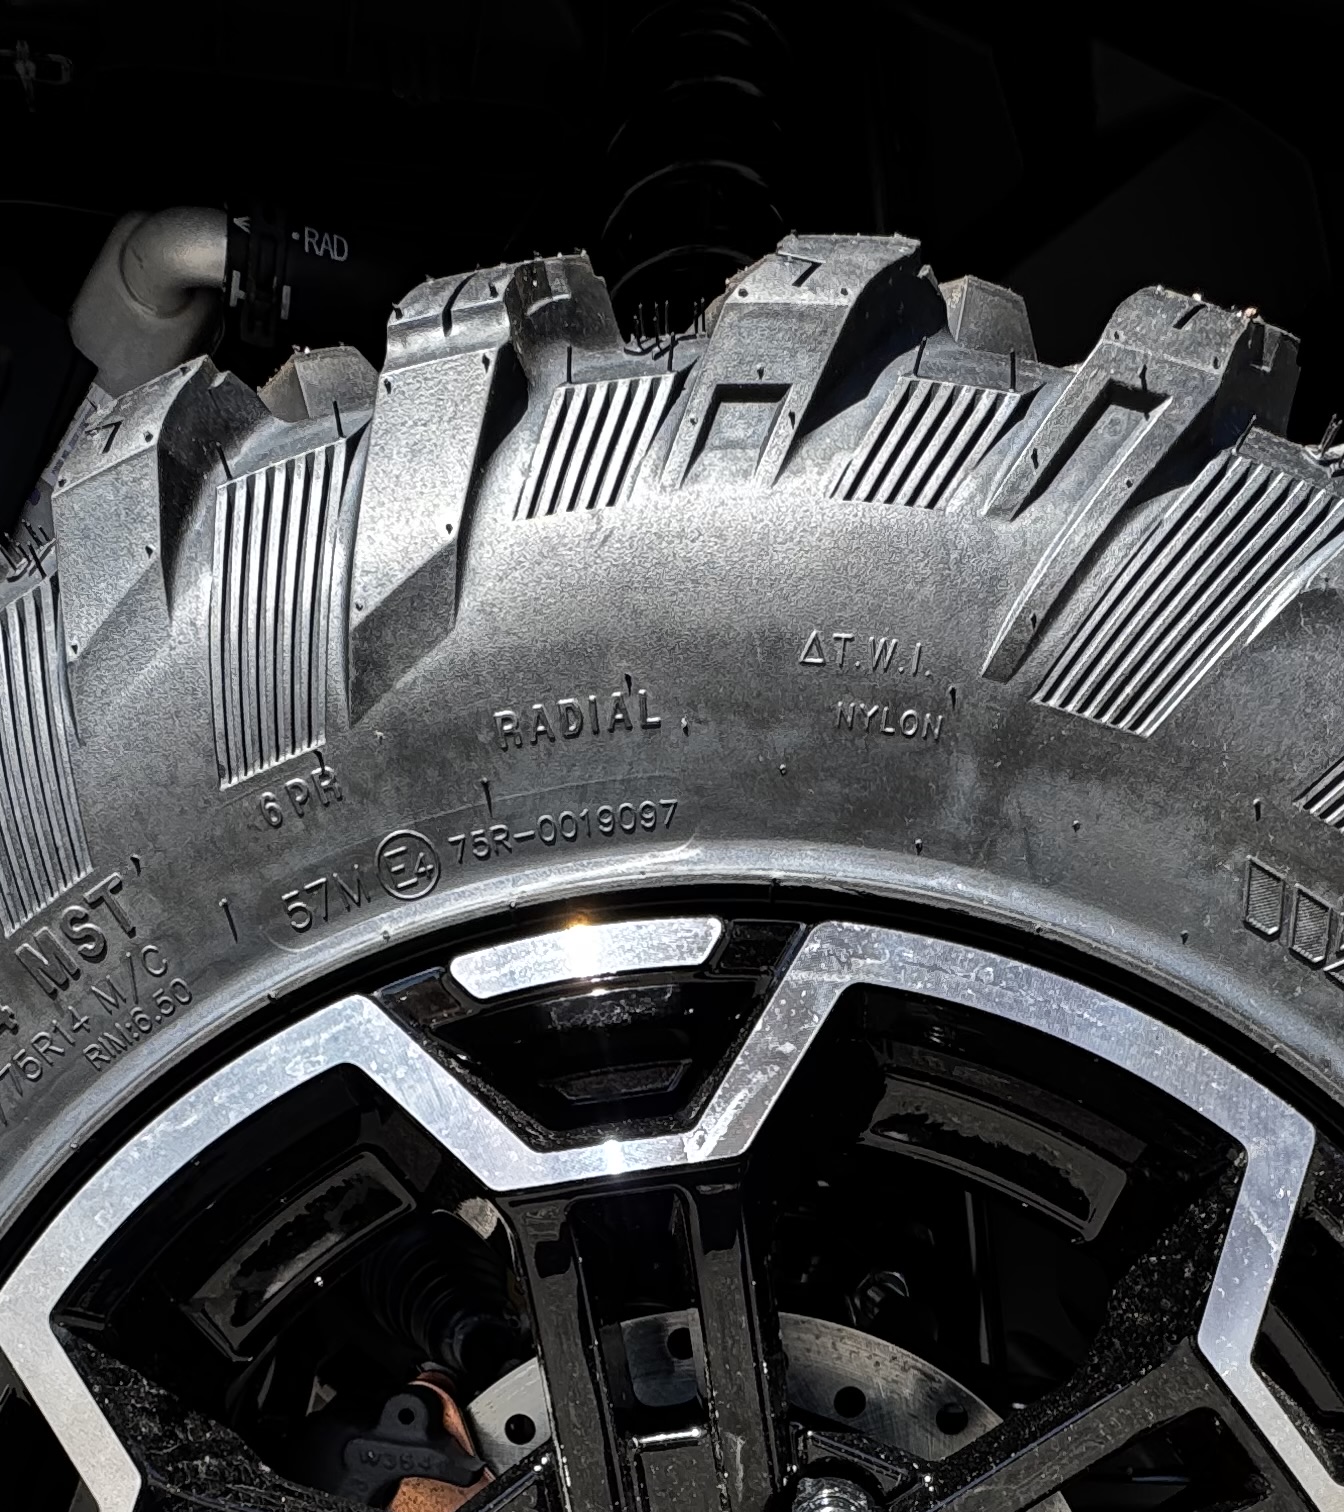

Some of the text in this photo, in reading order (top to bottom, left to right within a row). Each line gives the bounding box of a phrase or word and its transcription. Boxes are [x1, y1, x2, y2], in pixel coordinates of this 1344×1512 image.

[303, 226, 349, 262] RAD
[494, 688, 662, 750] RADIAL
[836, 699, 944, 741] NYLON
[282, 863, 370, 932] 57M
[447, 799, 678, 866] 75R-0019097
[15, 871, 137, 996] MST
[91, 944, 169, 1015] M/C
[82, 976, 194, 1072] RIM:6.50
